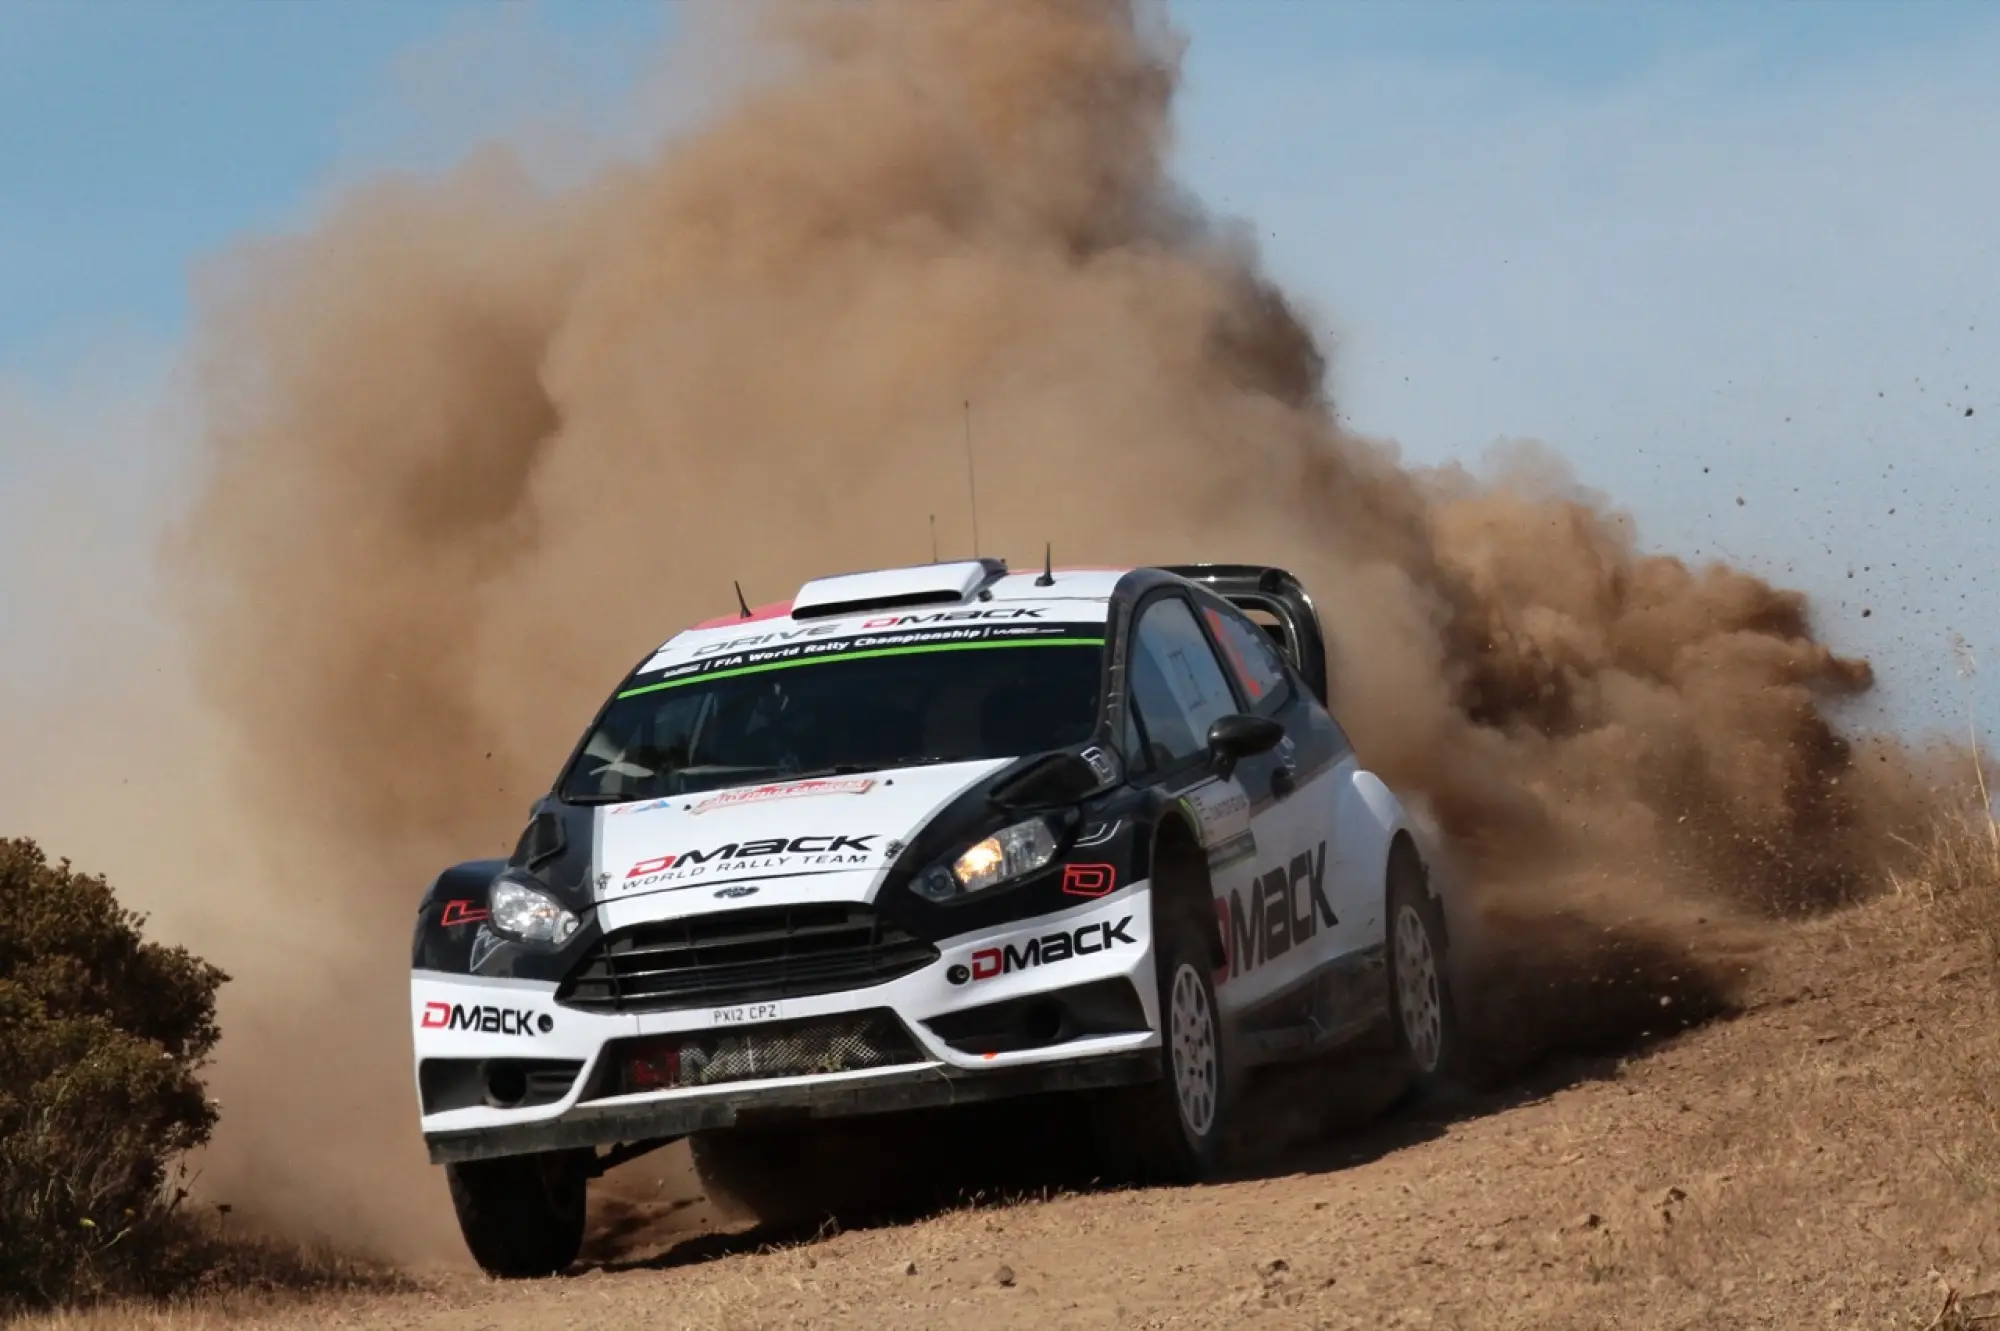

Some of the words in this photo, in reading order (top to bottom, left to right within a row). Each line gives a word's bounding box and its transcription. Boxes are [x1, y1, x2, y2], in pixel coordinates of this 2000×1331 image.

[692, 623, 842, 657] DRIVE
[714, 656, 743, 668] FIA
[749, 646, 801, 662] World
[803, 641, 850, 654] Rally
[853, 628, 982, 648] Championship
[622, 866, 706, 890] WORLD
[716, 856, 793, 873] RALLY
[802, 853, 869, 865] TEAM
[713, 1009, 745, 1023] PX12
[749, 1004, 777, 1019] CPZ
